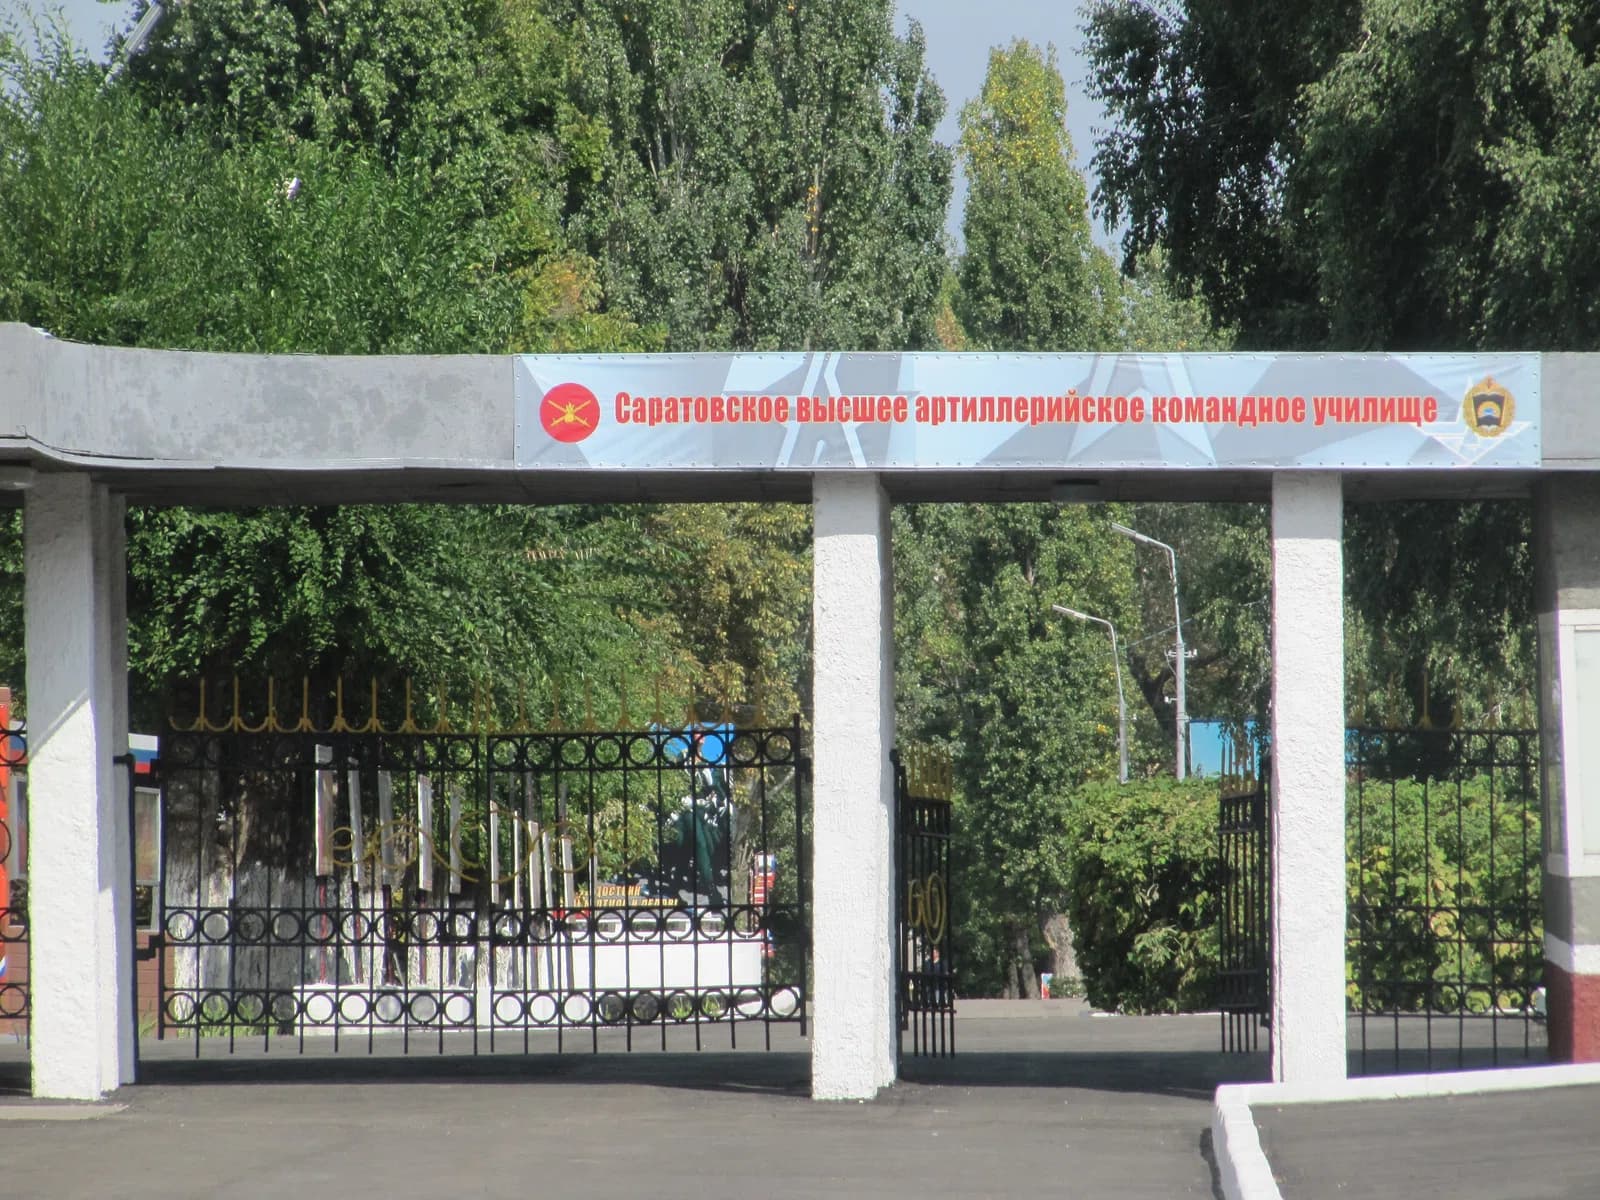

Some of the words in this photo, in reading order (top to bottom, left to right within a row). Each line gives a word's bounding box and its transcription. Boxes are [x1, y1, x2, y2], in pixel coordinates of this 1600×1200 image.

[615, 391, 790, 427] Саратовское
[795, 395, 909, 424] высшее
[914, 388, 1145, 427] артиллерийское
[1151, 395, 1306, 428] командное
[1311, 395, 1438, 427] училище
